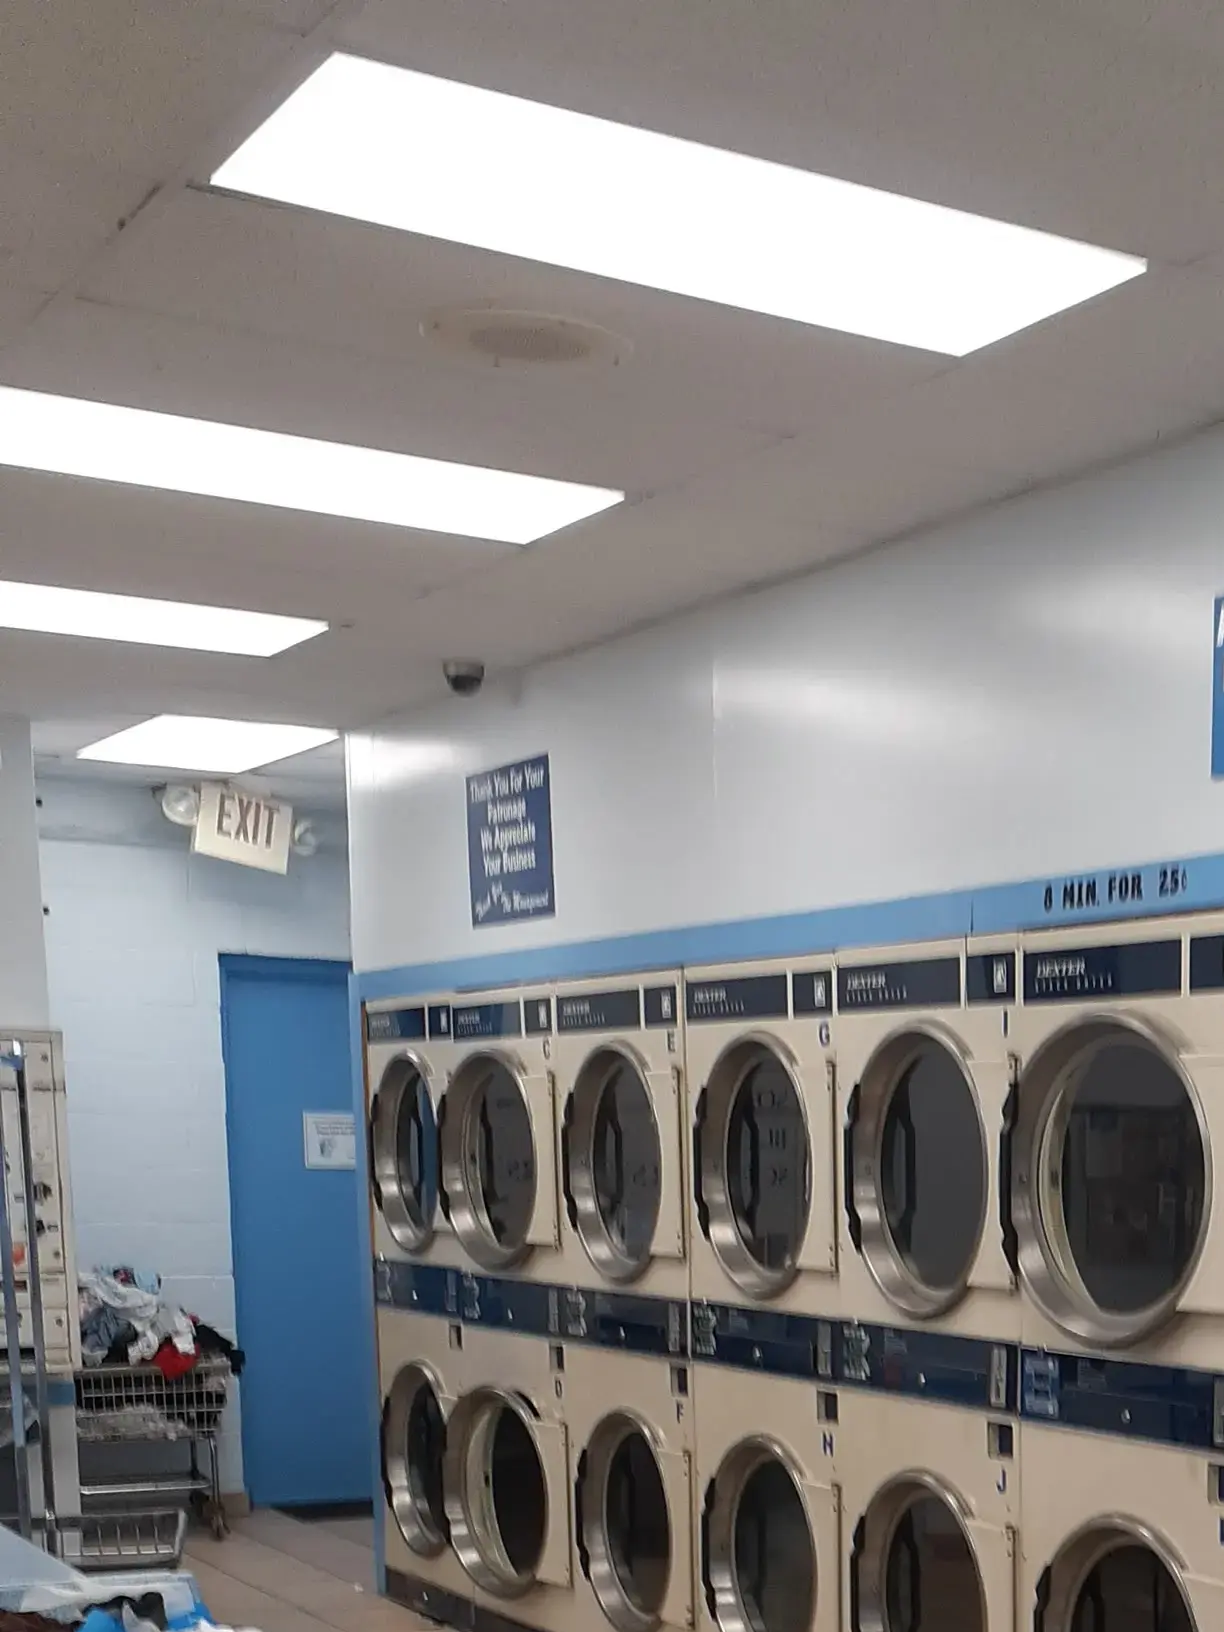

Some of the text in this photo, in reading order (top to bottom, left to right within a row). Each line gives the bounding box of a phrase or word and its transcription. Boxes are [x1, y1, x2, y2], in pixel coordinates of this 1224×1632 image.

[470, 764, 545, 802] Thank You For Your
[216, 793, 280, 849] EXIT
[488, 797, 526, 824] Patronage
[481, 821, 536, 852] We Appreciate
[483, 847, 536, 877] Your Business
[1108, 871, 1143, 903] FOR
[822, 1432, 834, 1457] H
[996, 1469, 1007, 1493] J
